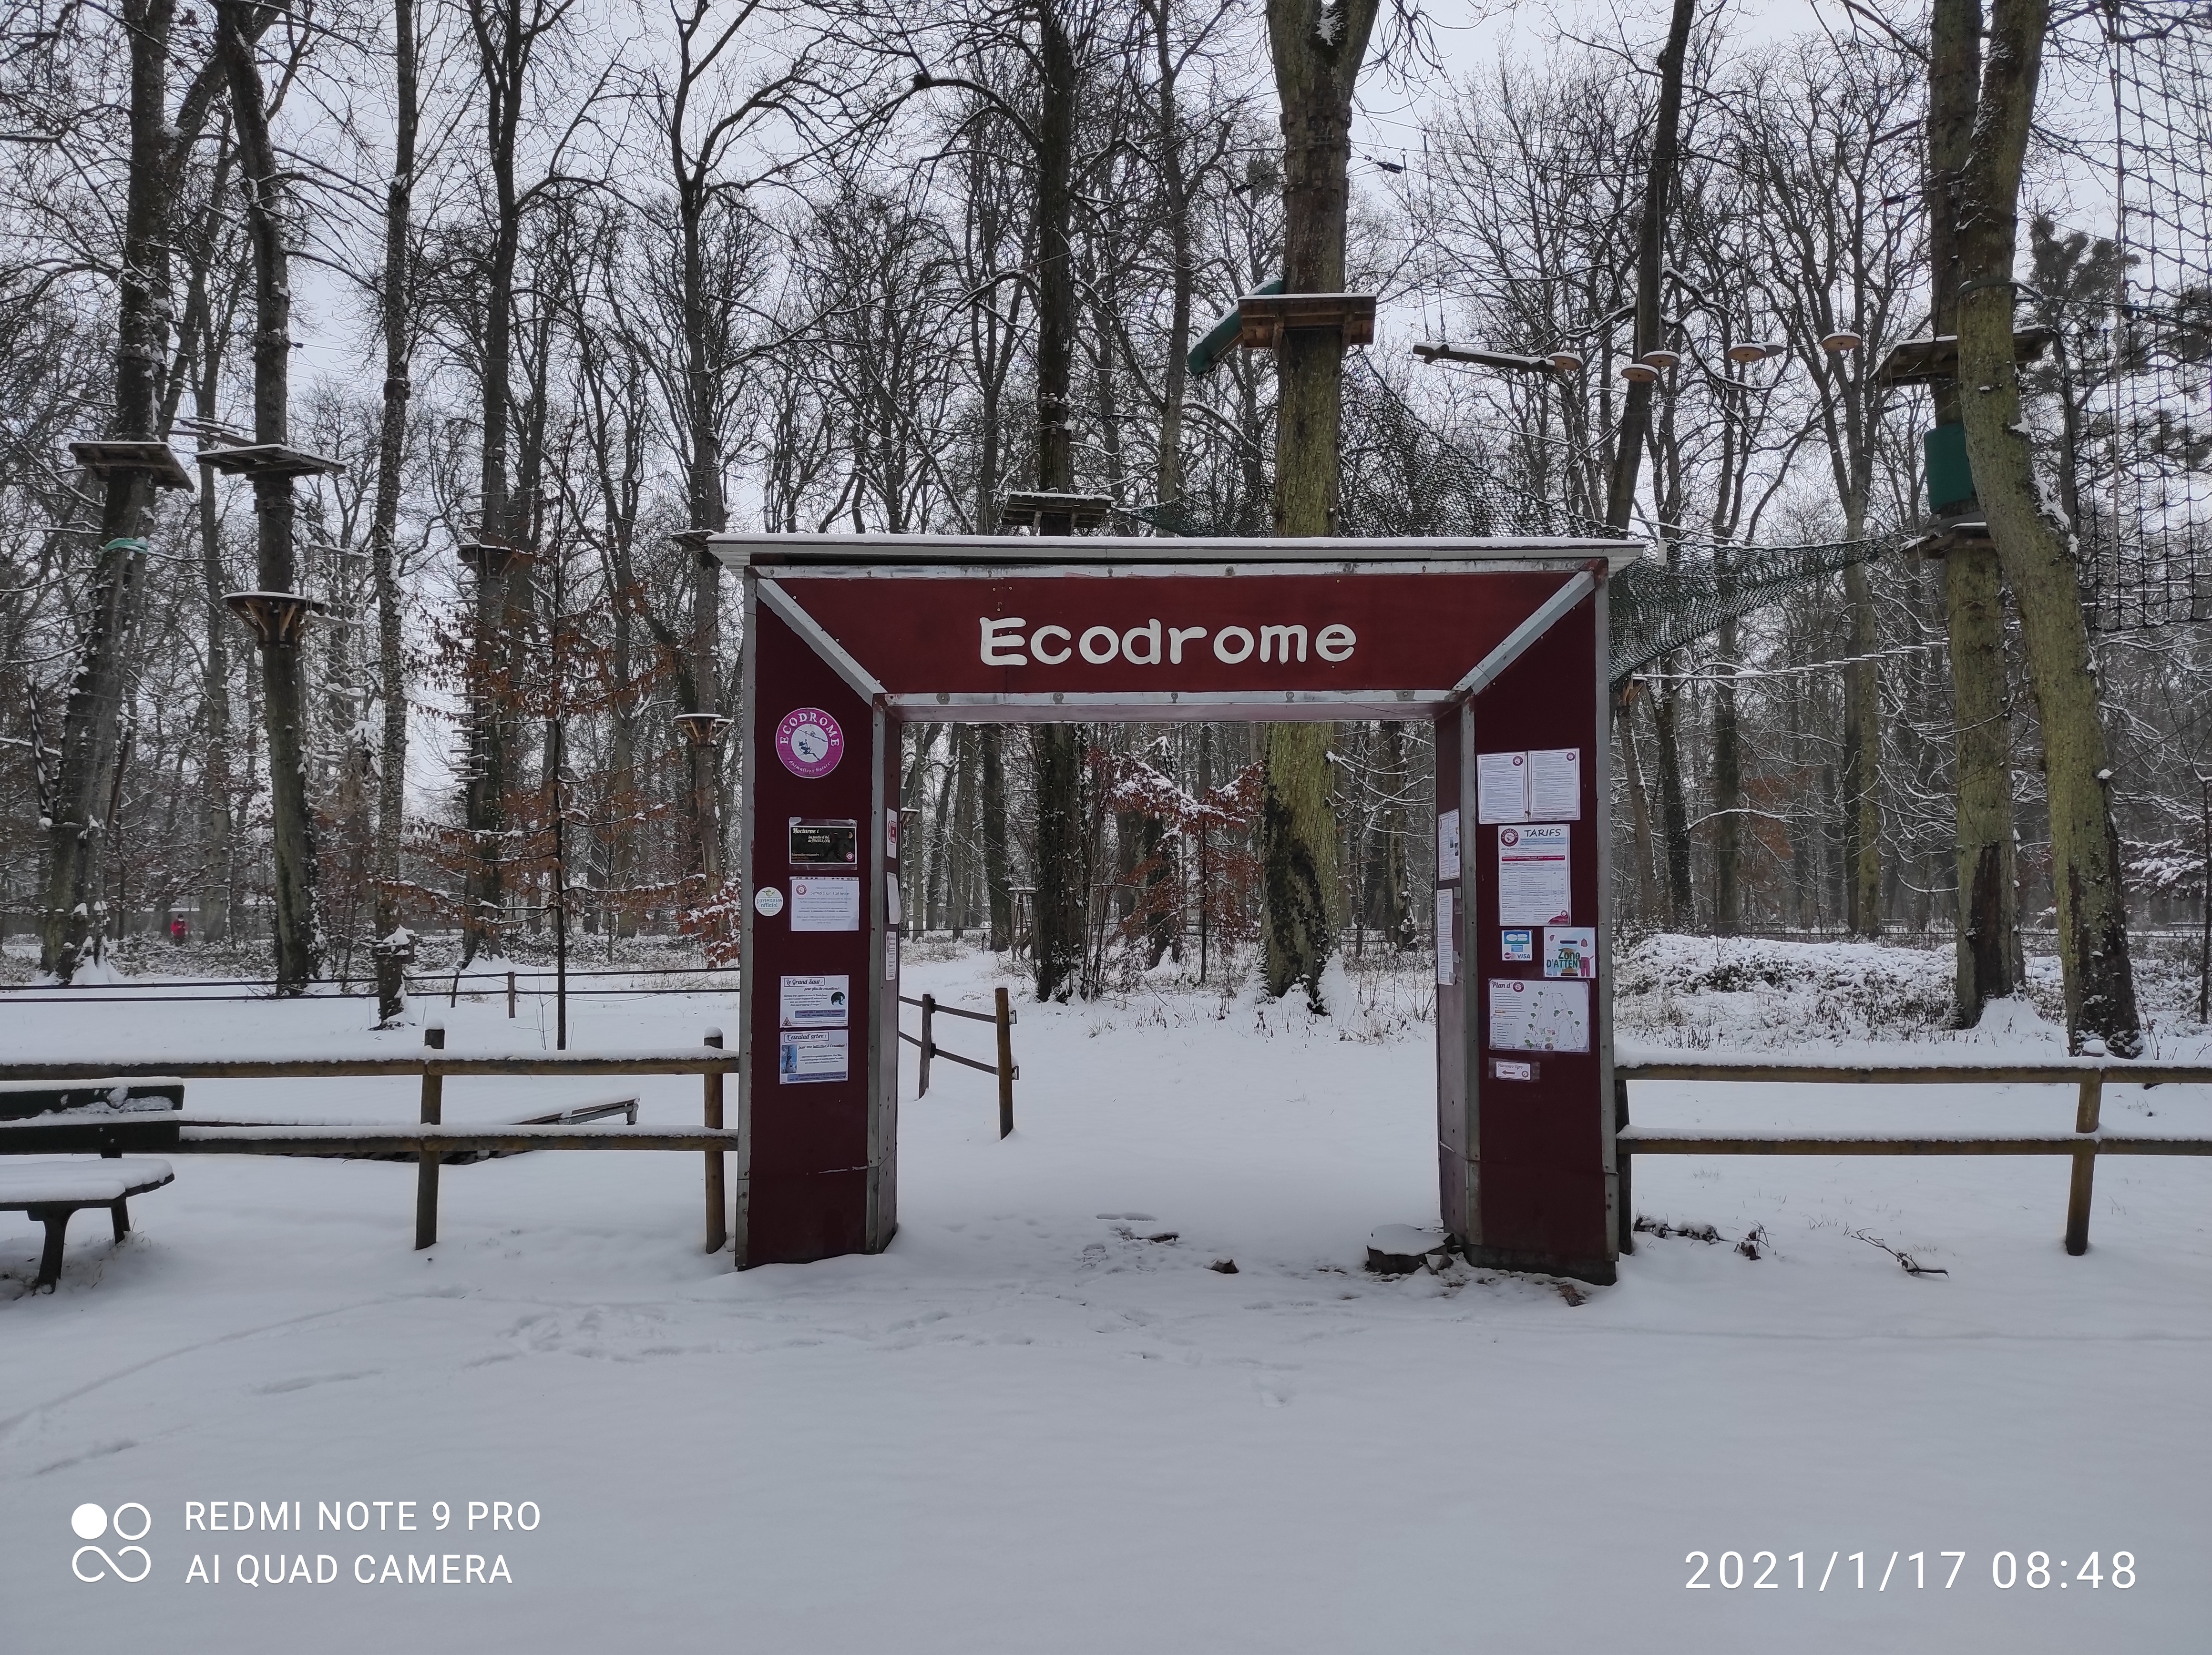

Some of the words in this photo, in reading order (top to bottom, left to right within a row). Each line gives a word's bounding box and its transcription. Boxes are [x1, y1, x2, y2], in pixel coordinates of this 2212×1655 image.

[979, 617, 1357, 666] Ecodrome
[780, 712, 840, 747] ECODROME
[1524, 828, 1561, 837] TARIFS
[1558, 949, 1581, 960] Zone
